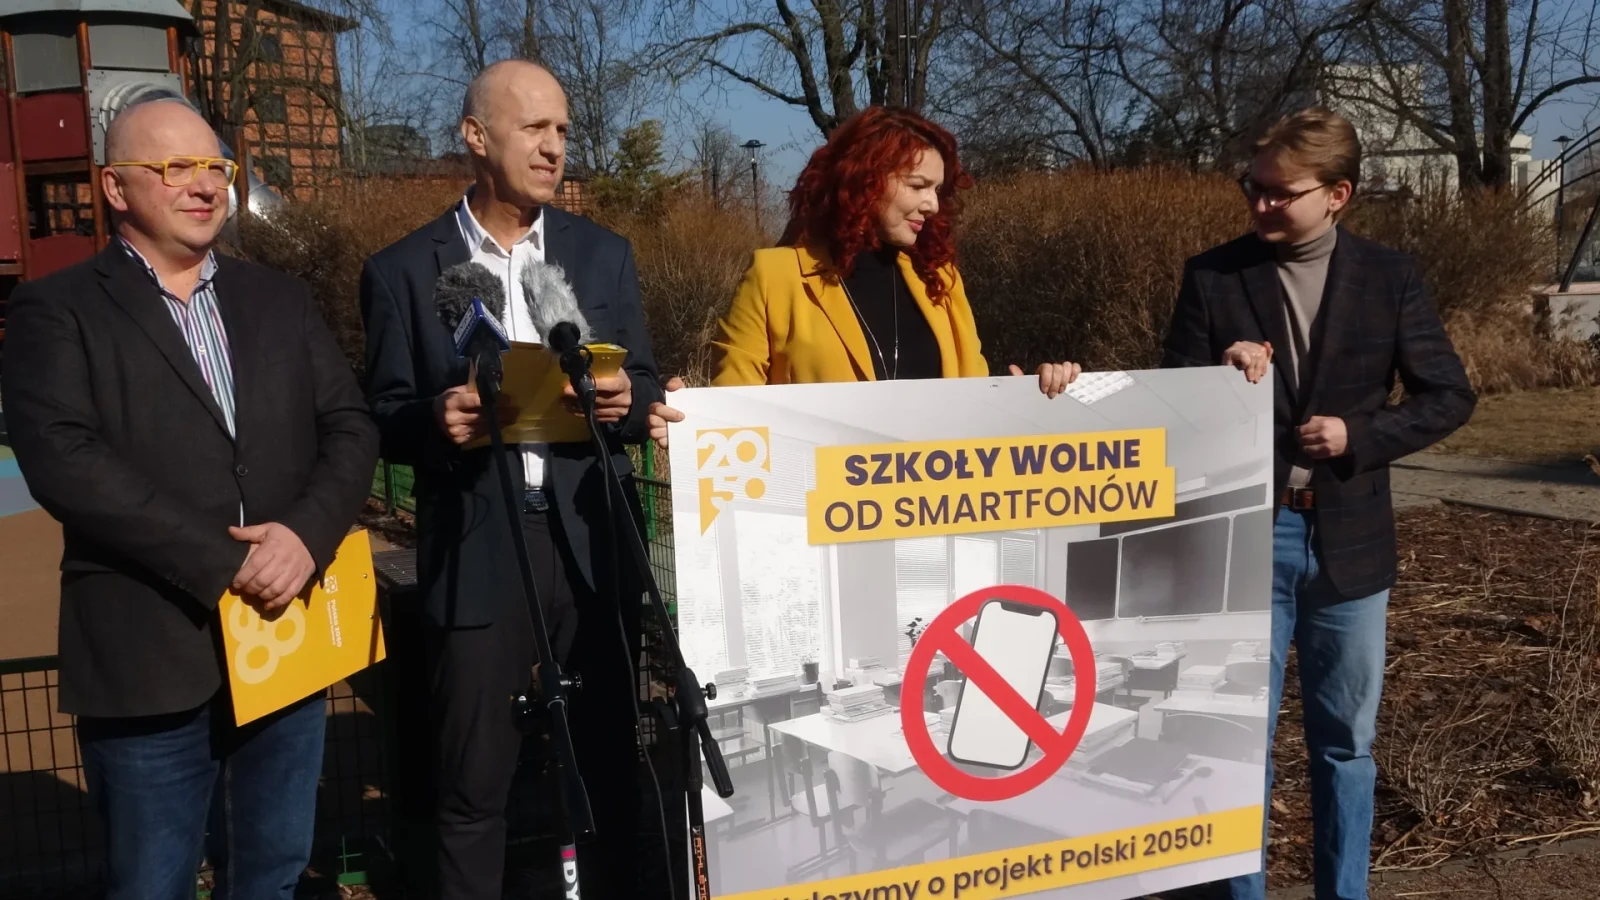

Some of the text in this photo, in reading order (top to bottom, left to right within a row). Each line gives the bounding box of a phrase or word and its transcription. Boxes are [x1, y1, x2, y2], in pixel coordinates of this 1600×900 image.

[845, 438, 1141, 486] SZKOŁY WOLNE
[824, 473, 1159, 532] OD SMARTFONÓW
[927, 876, 946, 895] o
[954, 853, 1053, 898] projekt
[1060, 835, 1136, 872] Polski
[1143, 823, 1213, 856] 2050!
